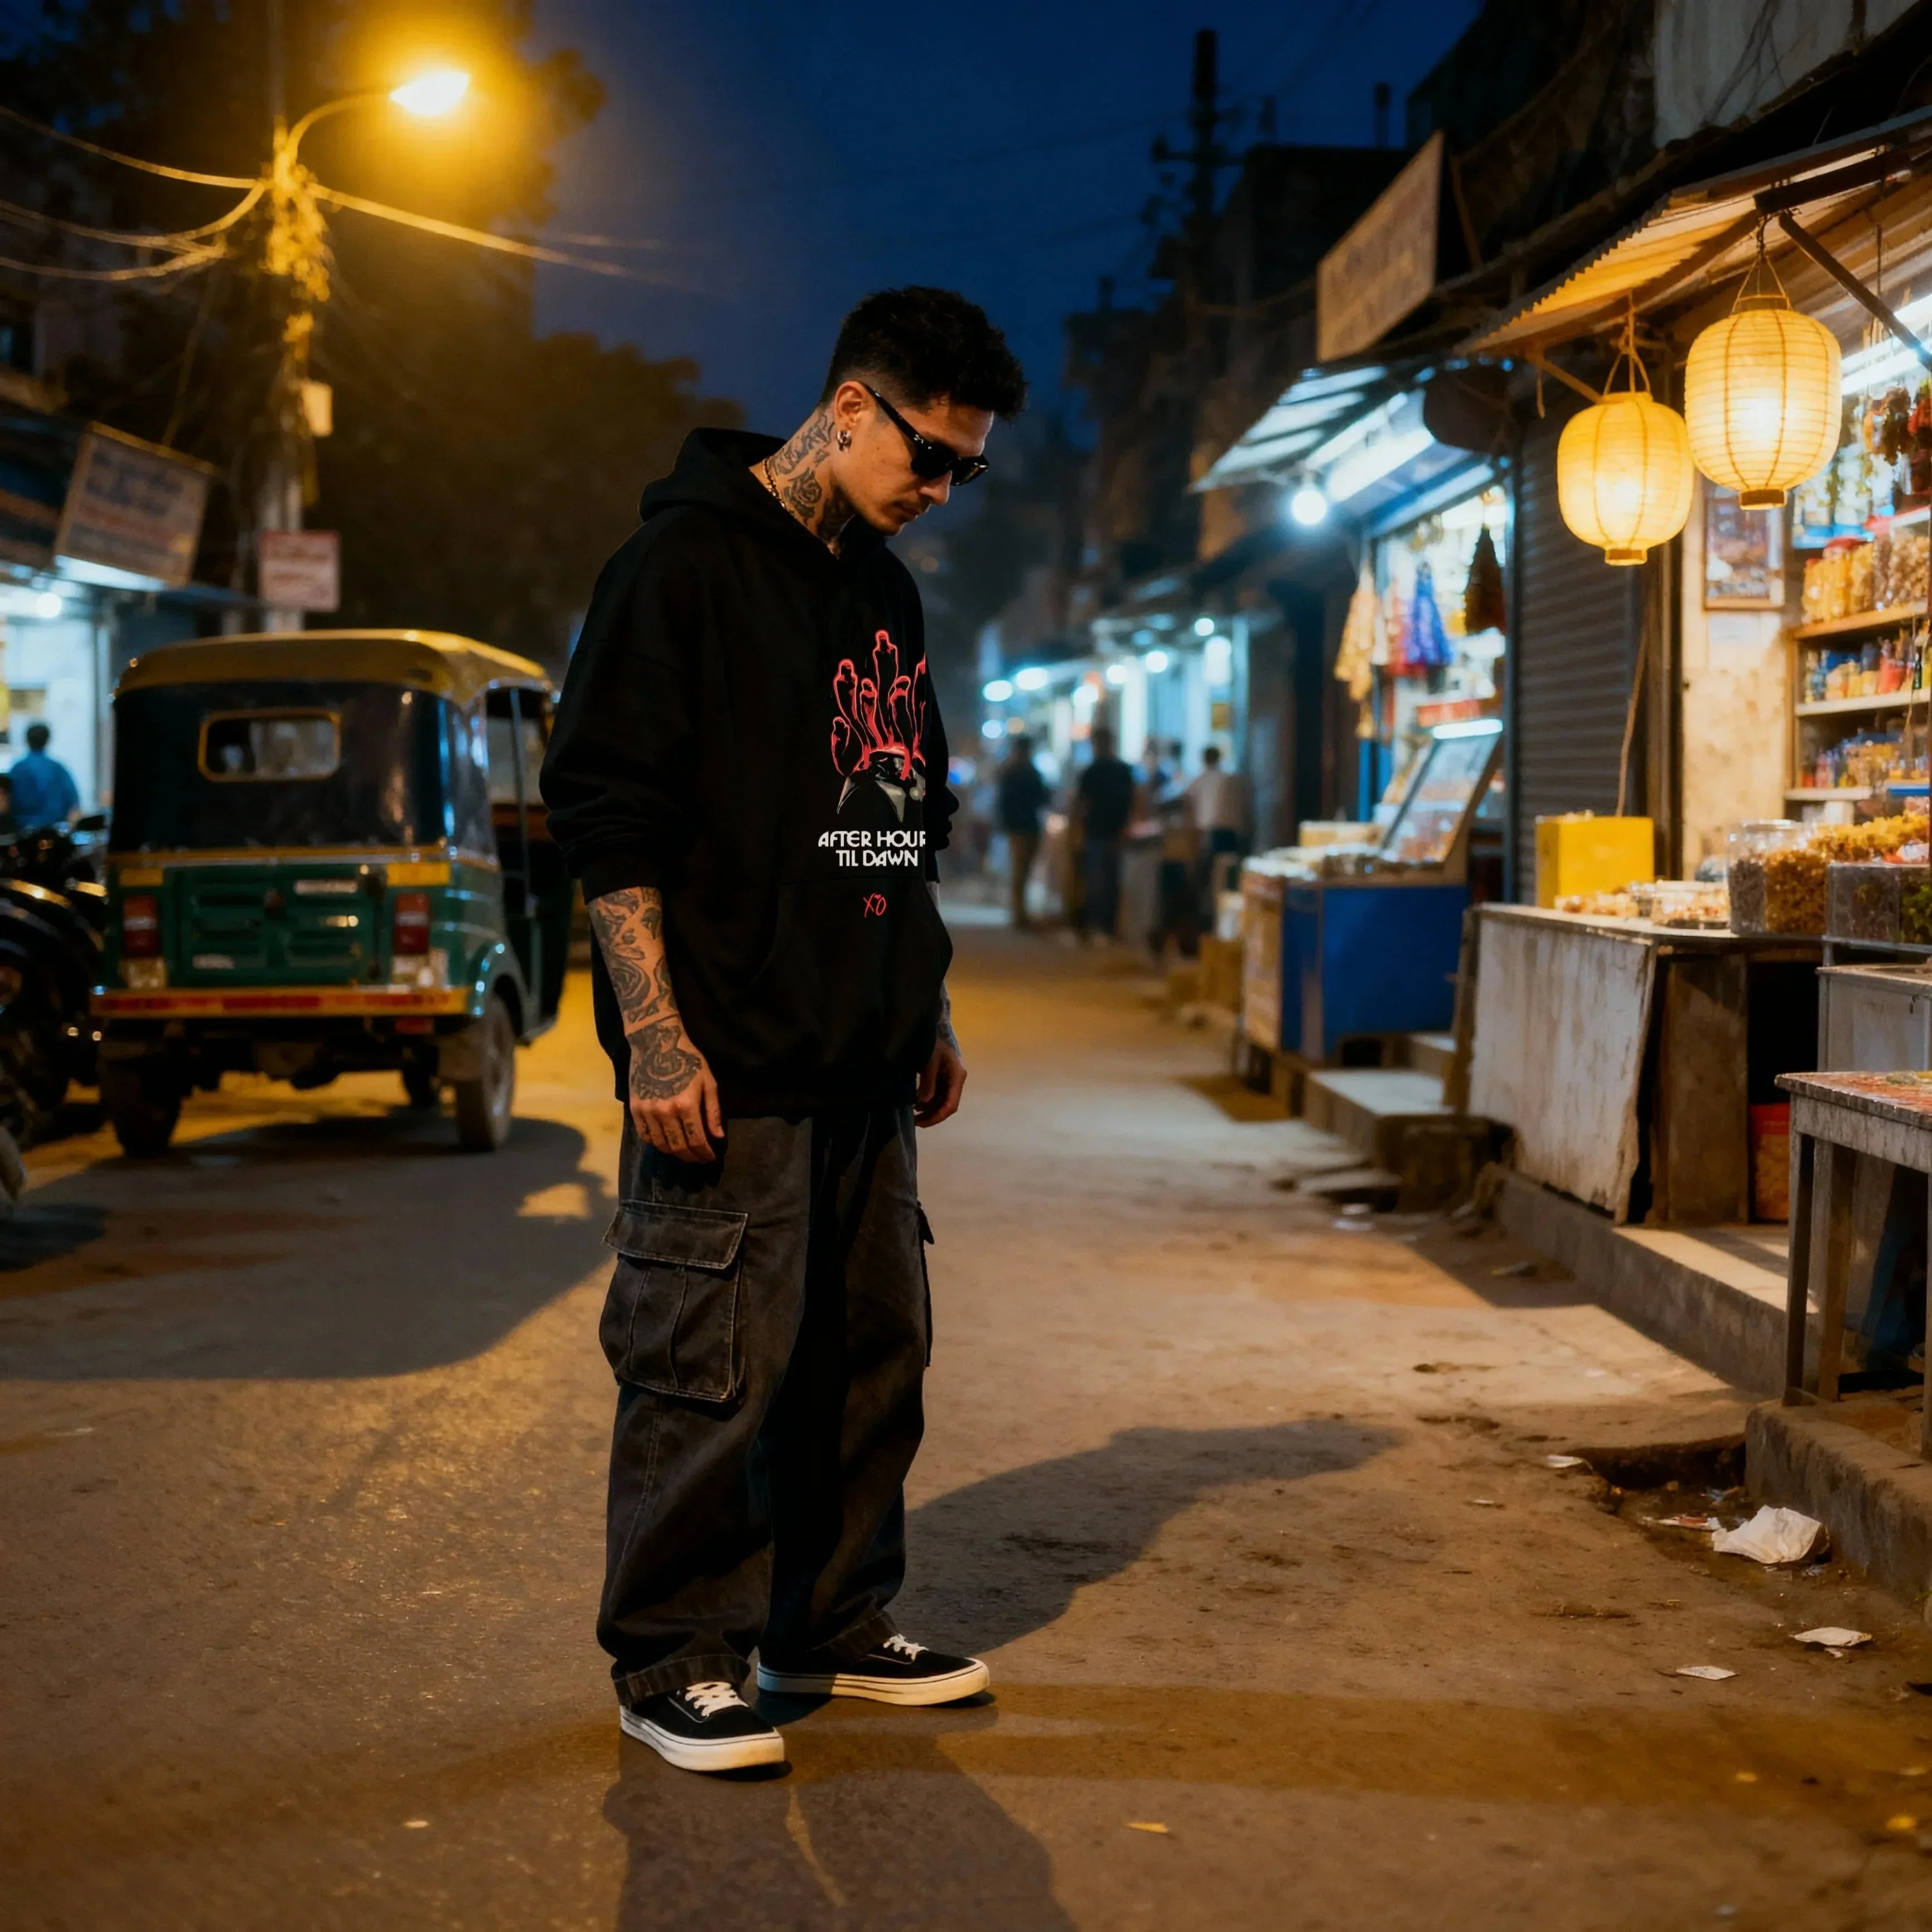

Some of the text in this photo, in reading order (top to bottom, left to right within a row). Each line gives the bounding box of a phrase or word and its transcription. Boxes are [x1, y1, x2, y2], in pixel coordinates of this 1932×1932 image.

[818, 830, 872, 848] AFTER
[835, 849, 919, 867] TIL DAWN
[863, 892, 887, 918] XO
